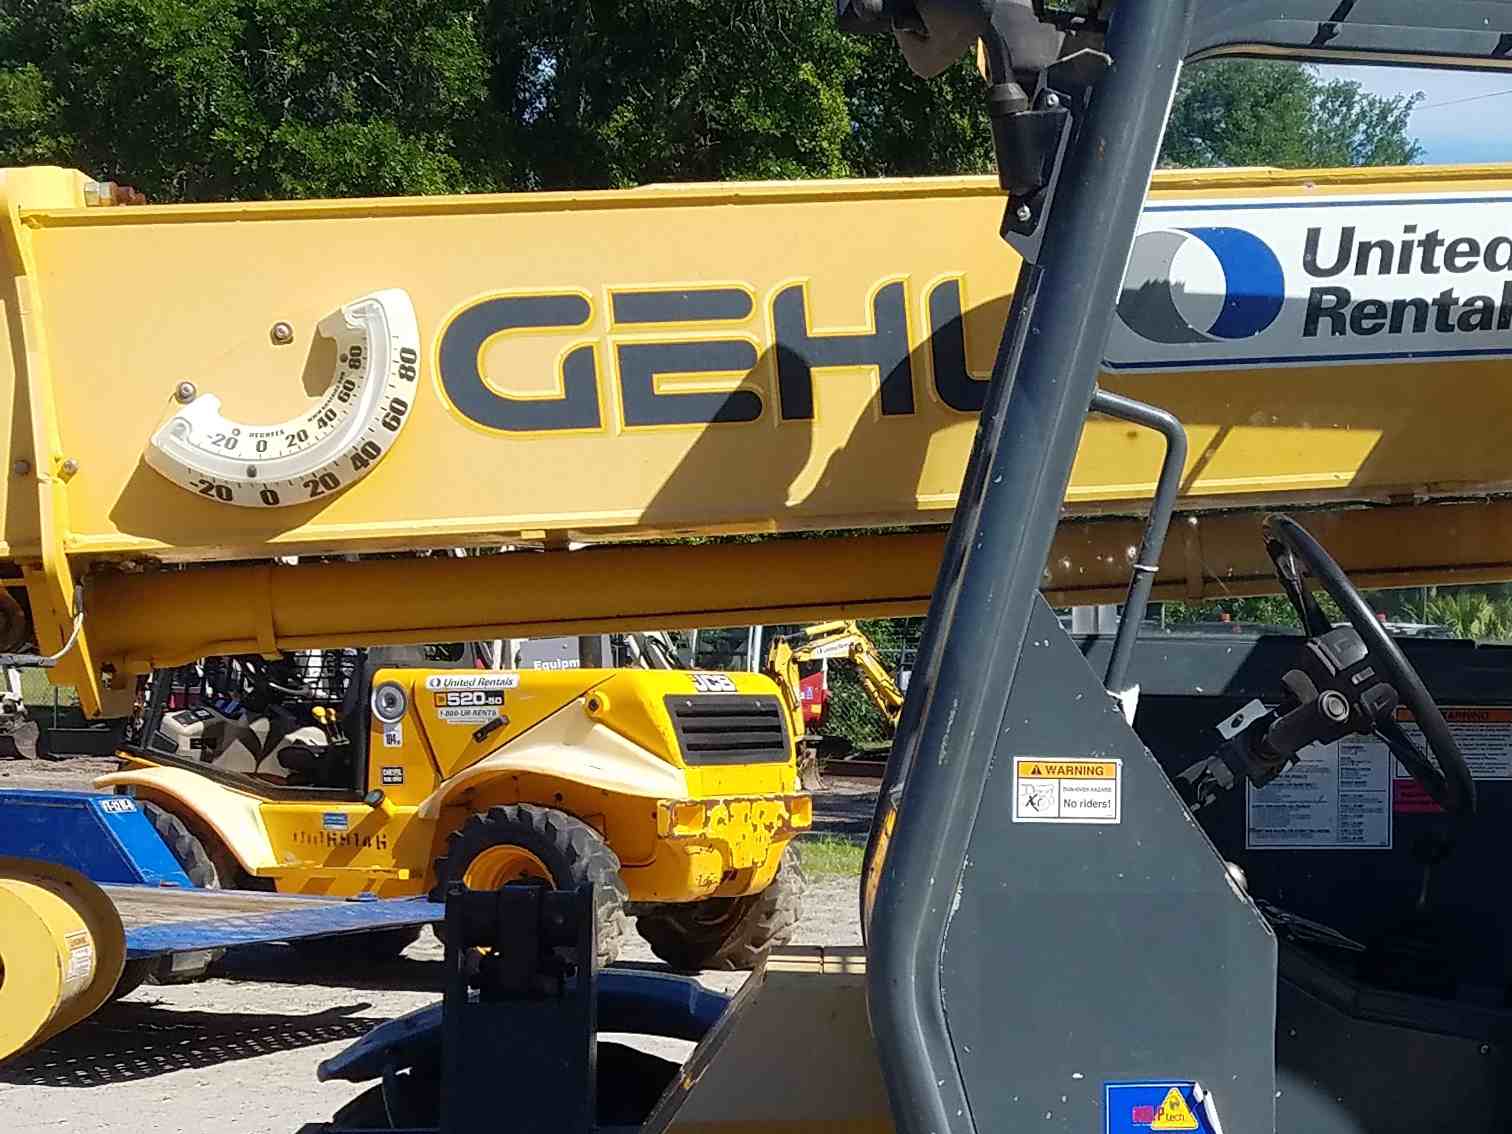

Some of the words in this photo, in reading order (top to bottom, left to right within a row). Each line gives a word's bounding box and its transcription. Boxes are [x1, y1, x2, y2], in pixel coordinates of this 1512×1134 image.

[256, 440, 268, 453] 0
[285, 429, 309, 448] 20
[317, 408, 337, 430] 40
[338, 379, 356, 404] 60
[348, 345, 362, 370] 80
[190, 477, 234, 502] -20
[259, 488, 280, 506] 0
[303, 471, 341, 498] 20
[350, 440, 382, 472] 40
[382, 397, 408, 432] 60
[398, 347, 417, 382] 80
[443, 677, 476, 687] United
[1045, 765, 1104, 776] WARNING
[1063, 799, 1077, 808] No
[1079, 799, 1111, 808] riders!
